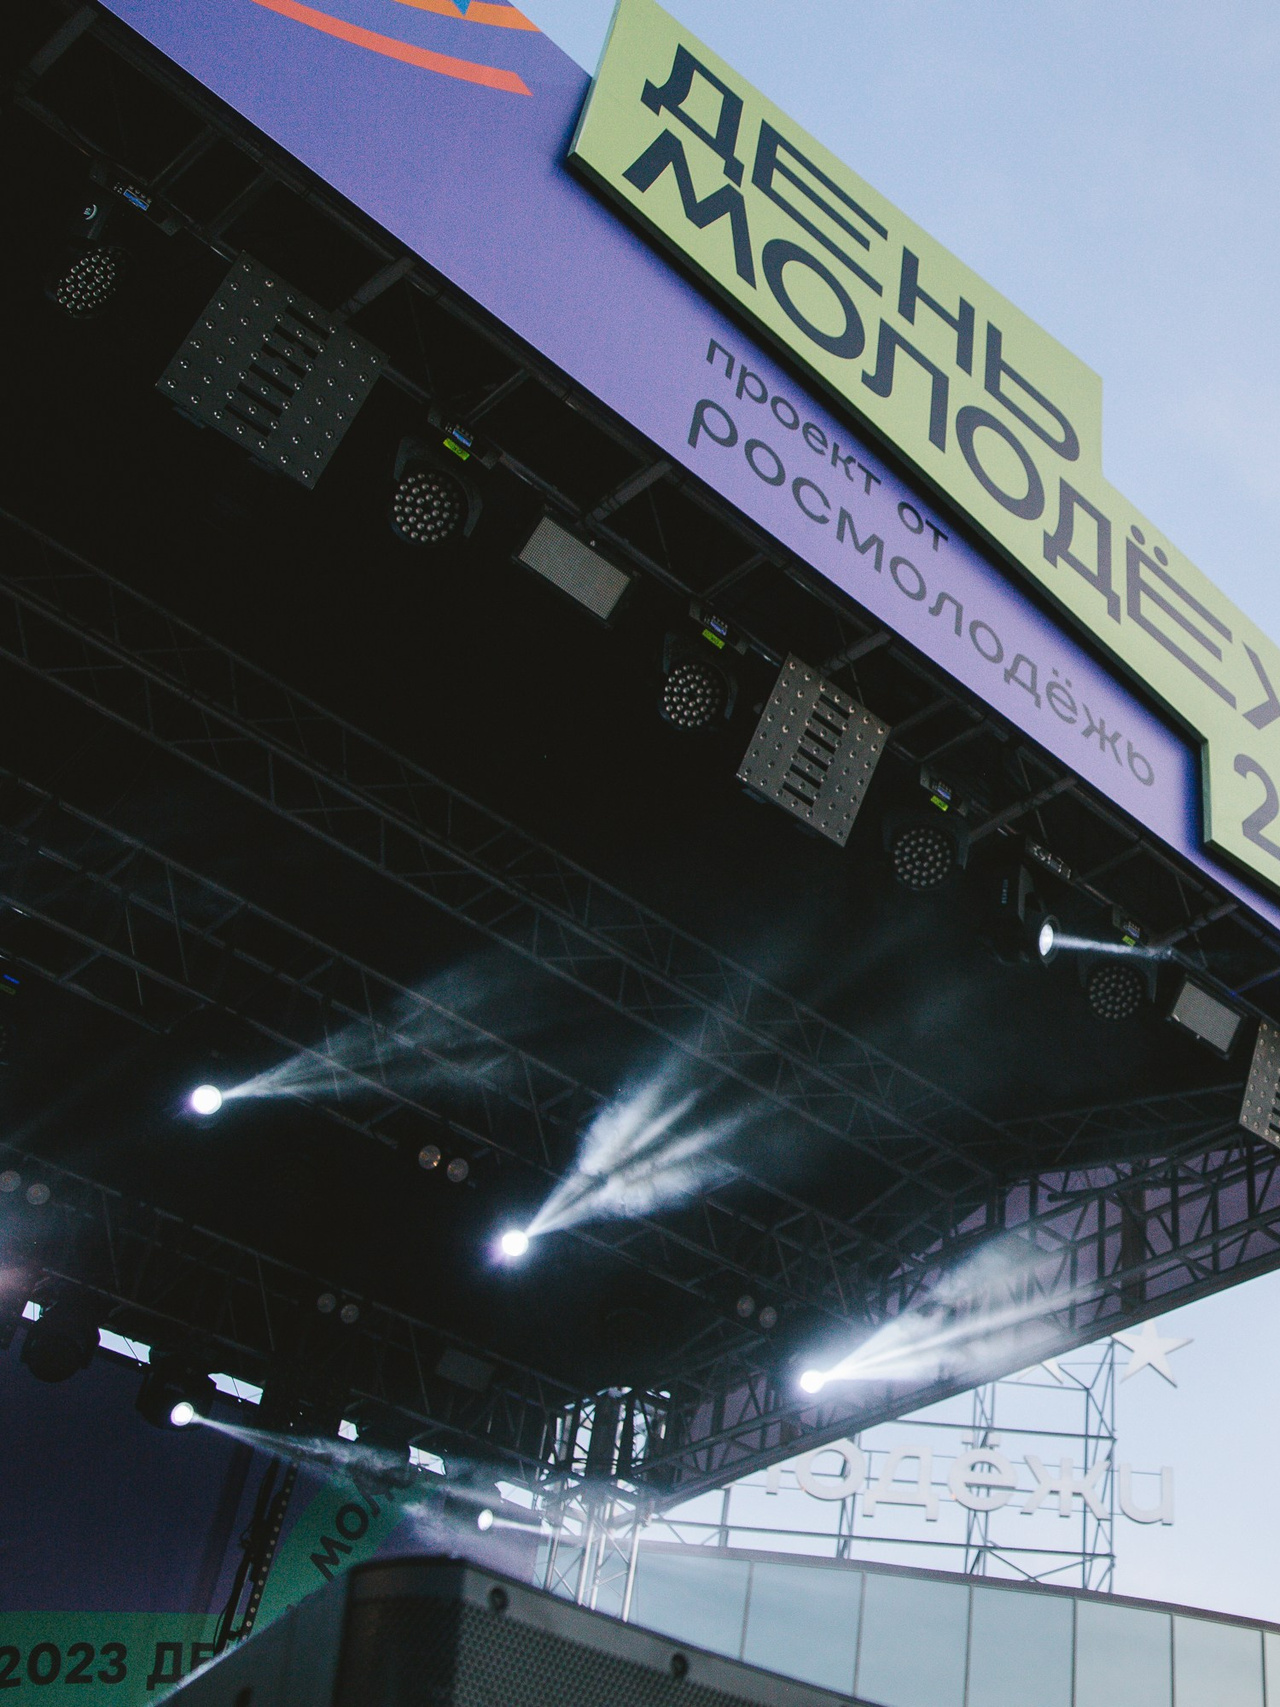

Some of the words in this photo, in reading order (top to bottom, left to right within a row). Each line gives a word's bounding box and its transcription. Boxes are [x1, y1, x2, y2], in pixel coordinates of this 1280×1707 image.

[640, 43, 1080, 462] ДЕНЬ
[706, 338, 882, 495] проект
[897, 501, 949, 552] от
[688, 398, 1155, 787] росмолодёжь
[722, 1431, 1174, 1526] одёжи
[0, 1642, 128, 1688] 2023
